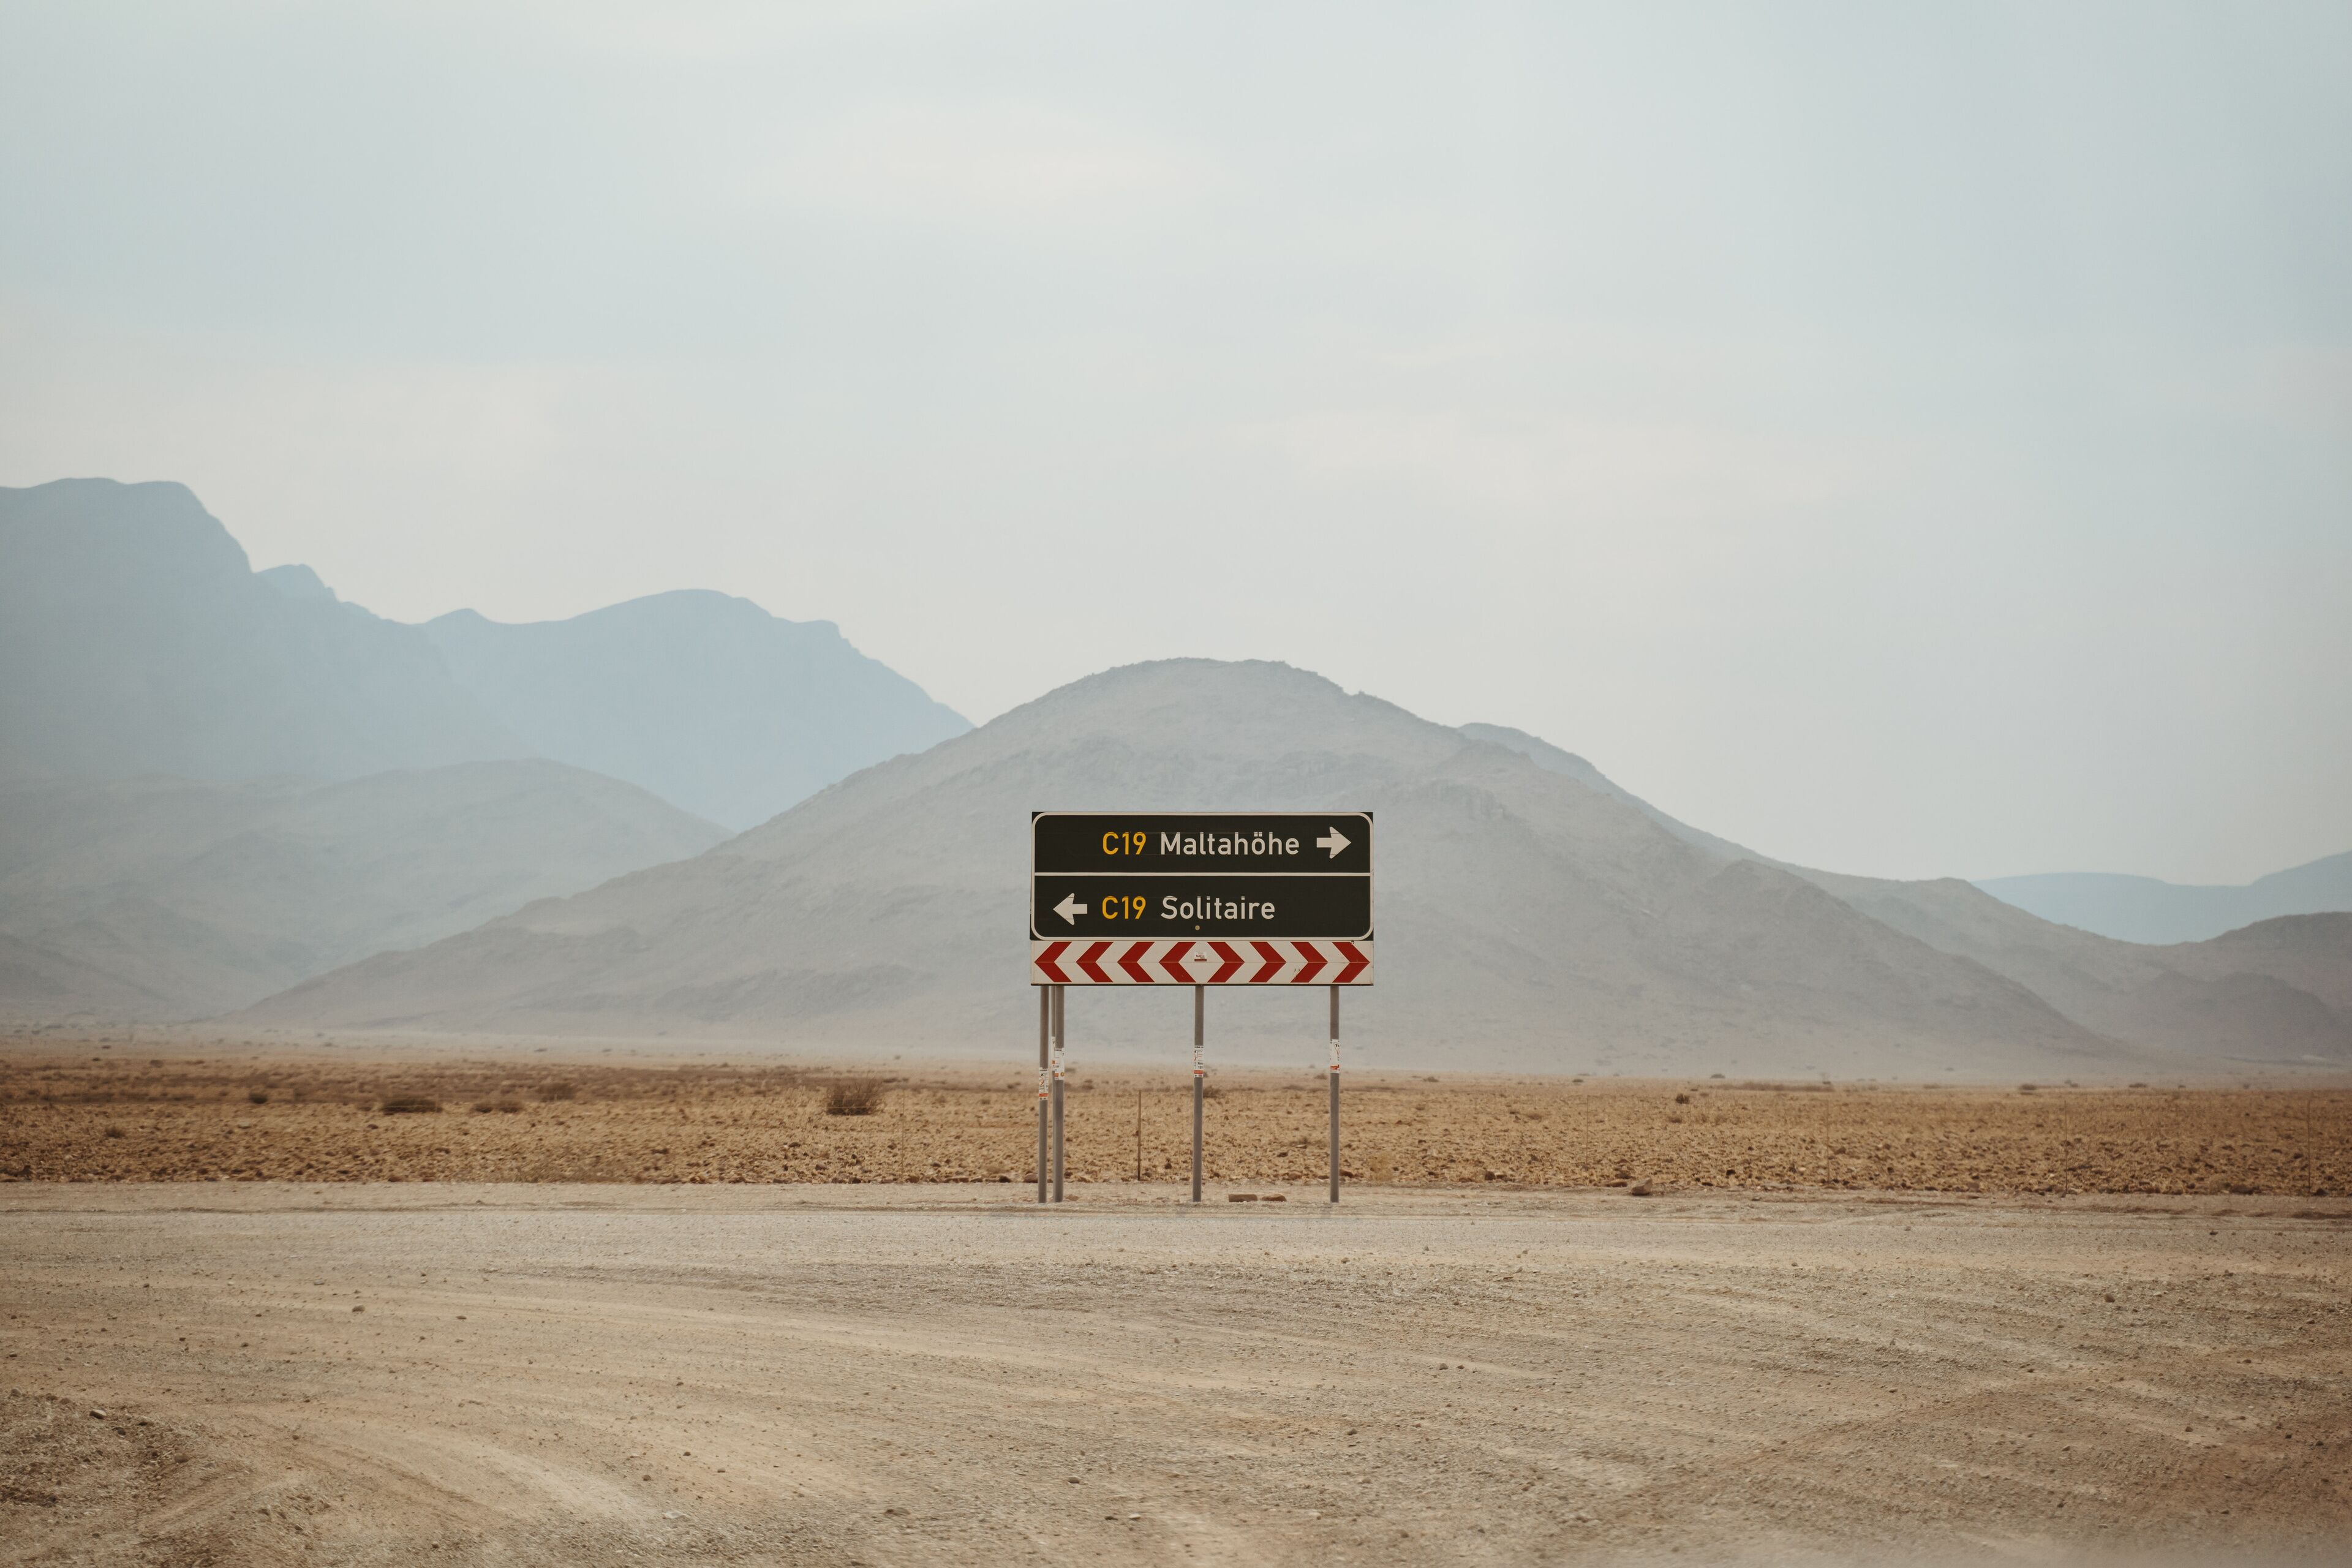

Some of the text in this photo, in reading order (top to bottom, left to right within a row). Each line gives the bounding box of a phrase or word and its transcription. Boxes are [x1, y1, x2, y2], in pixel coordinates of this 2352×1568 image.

[1102, 831, 1300, 855] C19 Maltahöhe
[1101, 895, 1275, 919] C19 Solitaire
